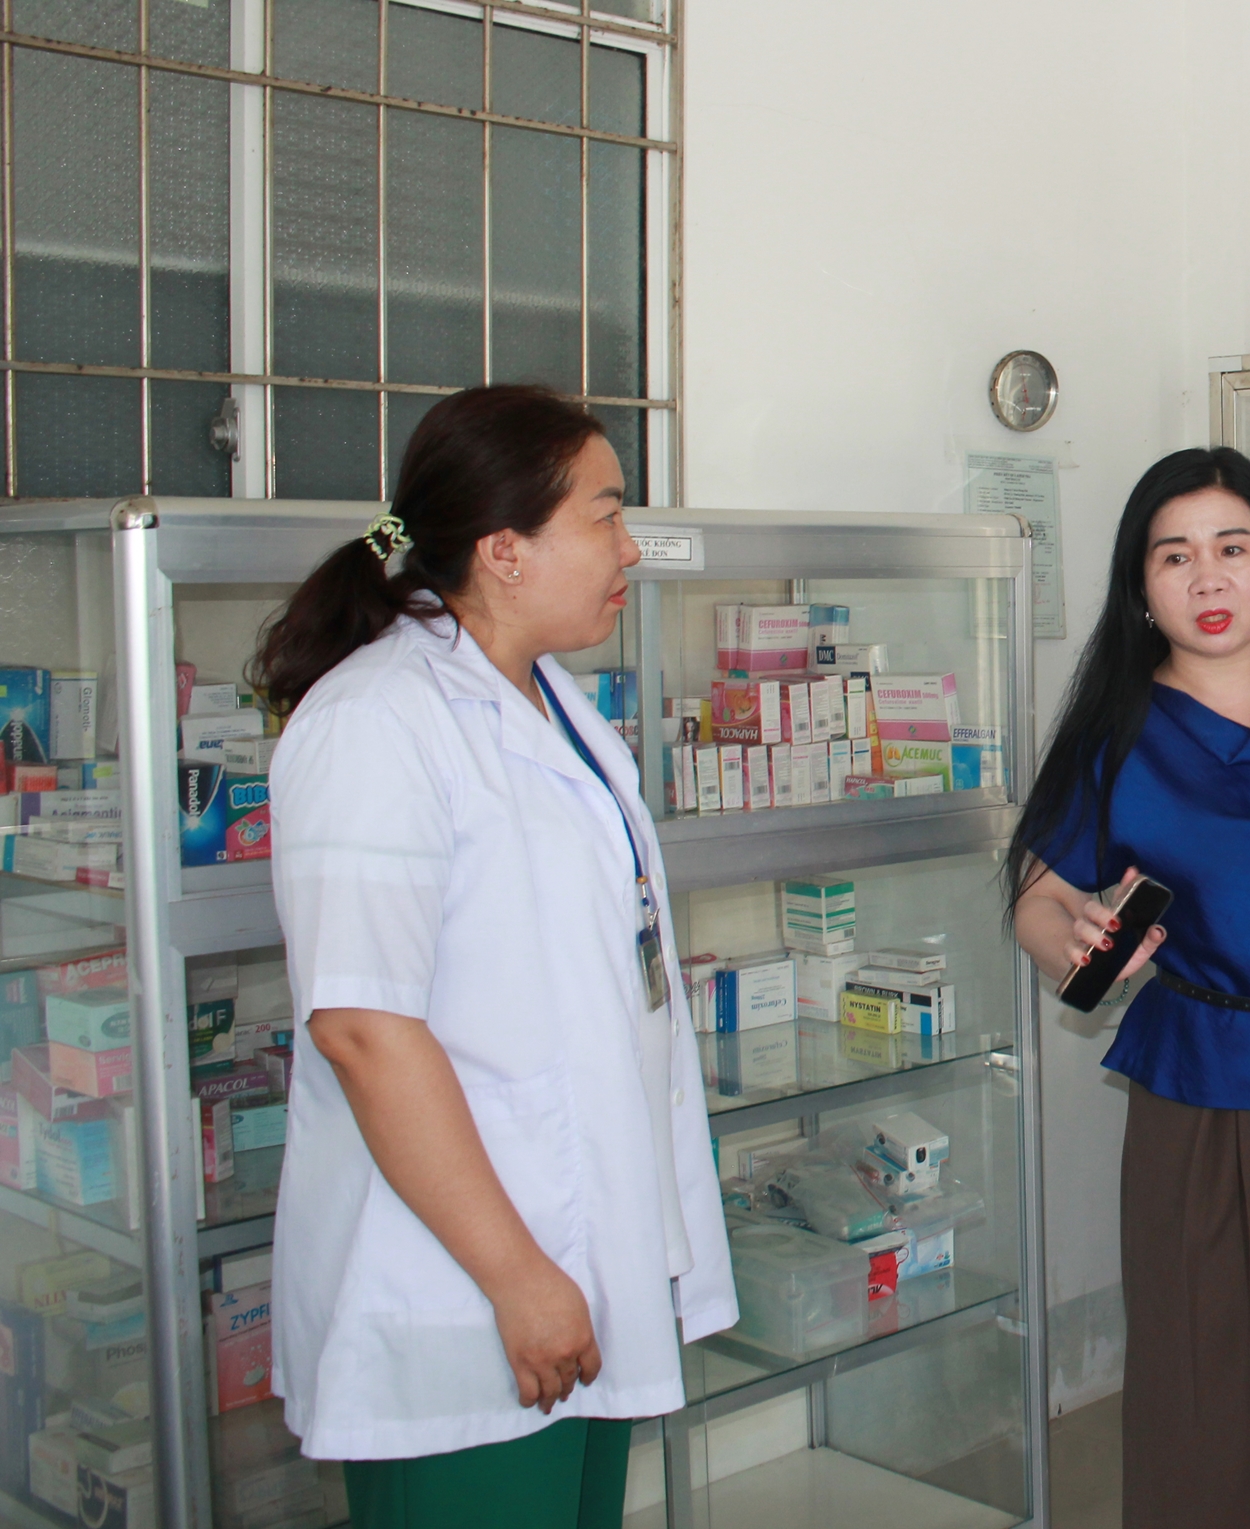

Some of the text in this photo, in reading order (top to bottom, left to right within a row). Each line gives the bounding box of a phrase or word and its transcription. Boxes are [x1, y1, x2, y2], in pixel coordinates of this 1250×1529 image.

[758, 619, 799, 629] CEFUROXIM
[818, 649, 834, 662] DMC
[877, 689, 922, 699] CEFUROXIM
[719, 727, 758, 740] HAPACOL
[953, 728, 996, 739] EFFERALGAN
[10, 721, 23, 761] anadol
[901, 746, 943, 761] ACEMUC
[188, 769, 199, 816] Panadol
[233, 784, 271, 807] BIB
[66, 952, 128, 980] ACEPR
[751, 998, 787, 1012] Cefuroxim
[849, 1000, 882, 1013] NYSTATIN
[255, 1023, 271, 1033] 200
[230, 1301, 271, 1331] ZYPFI
